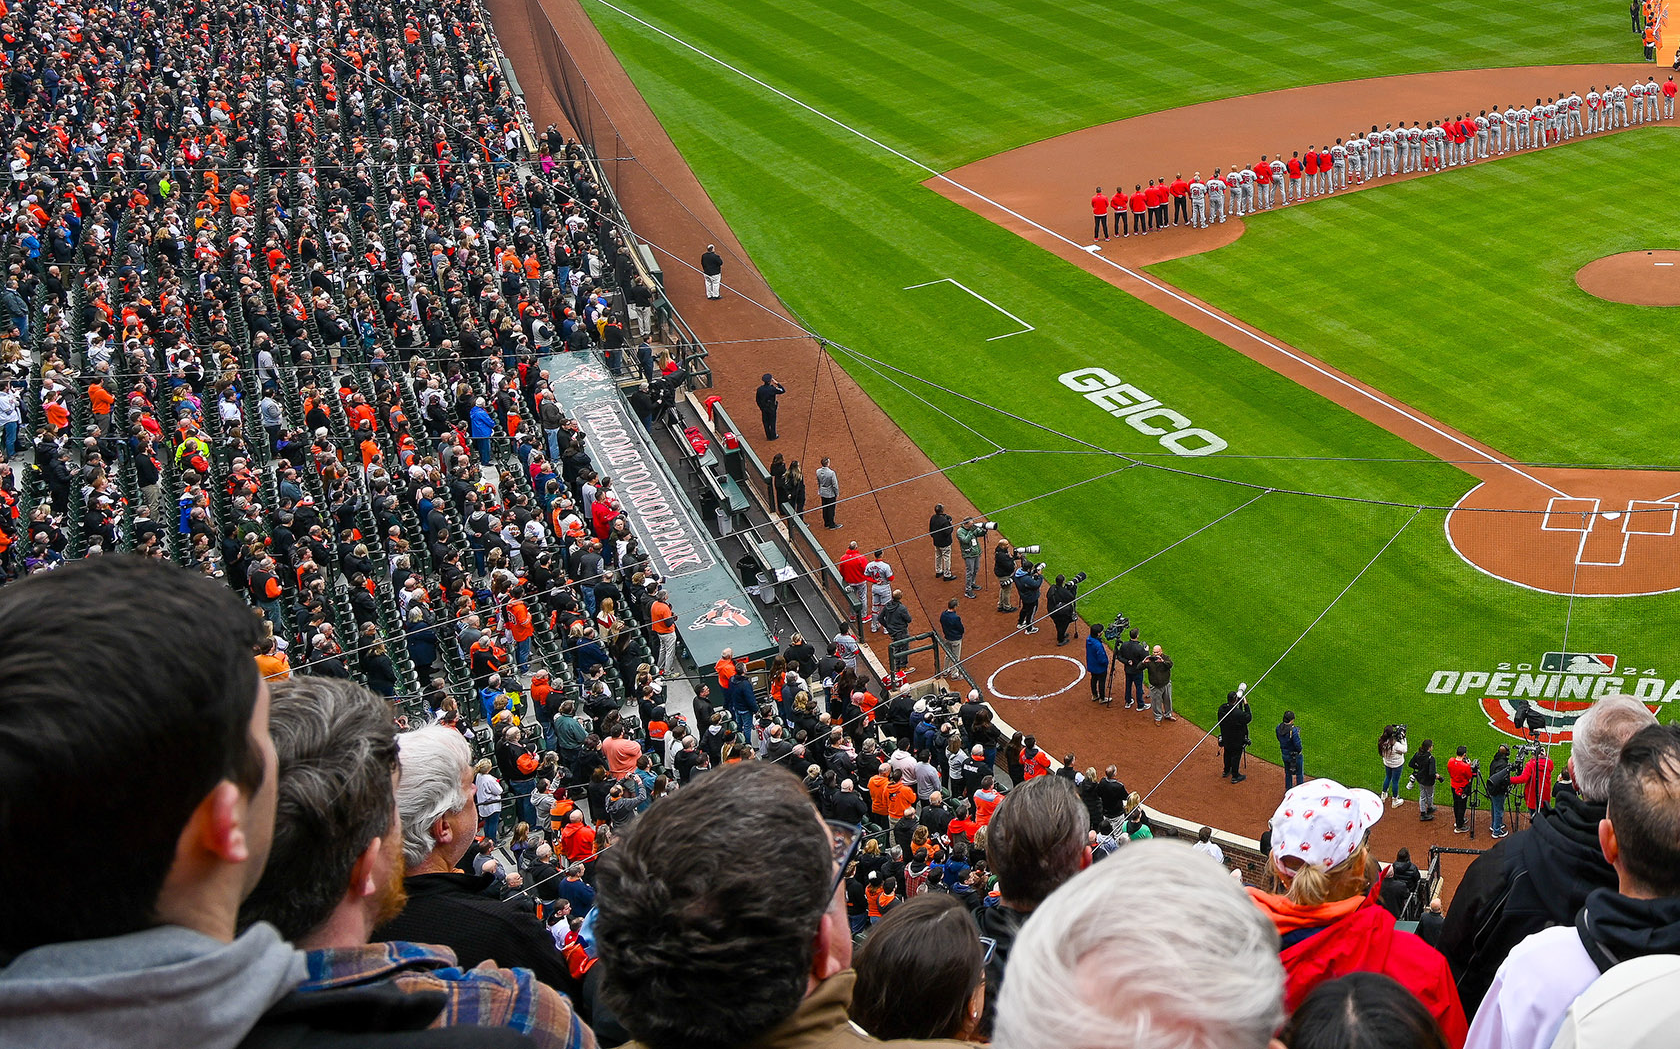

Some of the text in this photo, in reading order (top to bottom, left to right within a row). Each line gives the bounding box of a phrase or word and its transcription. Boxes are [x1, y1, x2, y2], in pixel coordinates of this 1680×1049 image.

[1058, 367, 1229, 458] GEICO
[583, 404, 702, 572] WELCOME TO ORIOLE PARK
[1424, 670, 1625, 699] OPENING
